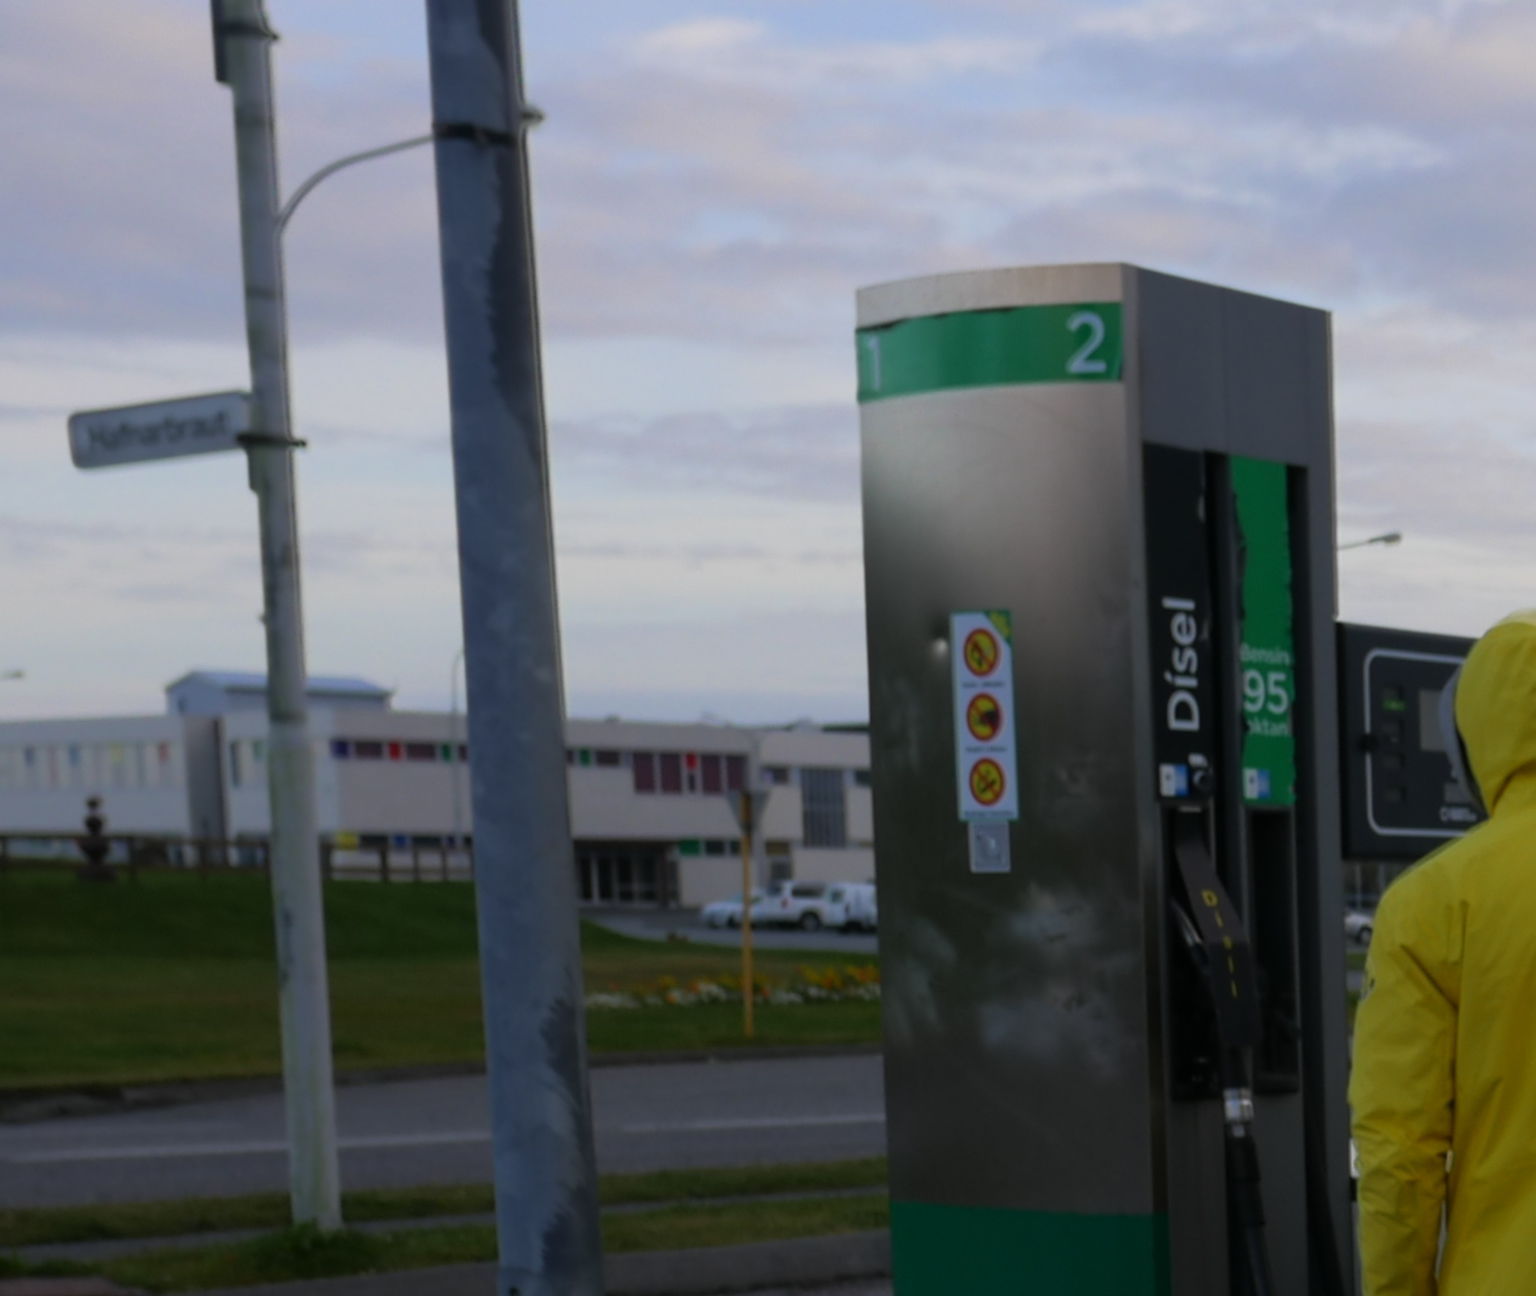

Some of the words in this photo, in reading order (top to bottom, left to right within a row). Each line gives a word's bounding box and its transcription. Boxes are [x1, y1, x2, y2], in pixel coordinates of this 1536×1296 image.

[866, 333, 882, 392] 1
[1065, 310, 1108, 374] 2
[1243, 668, 1290, 716] 95
